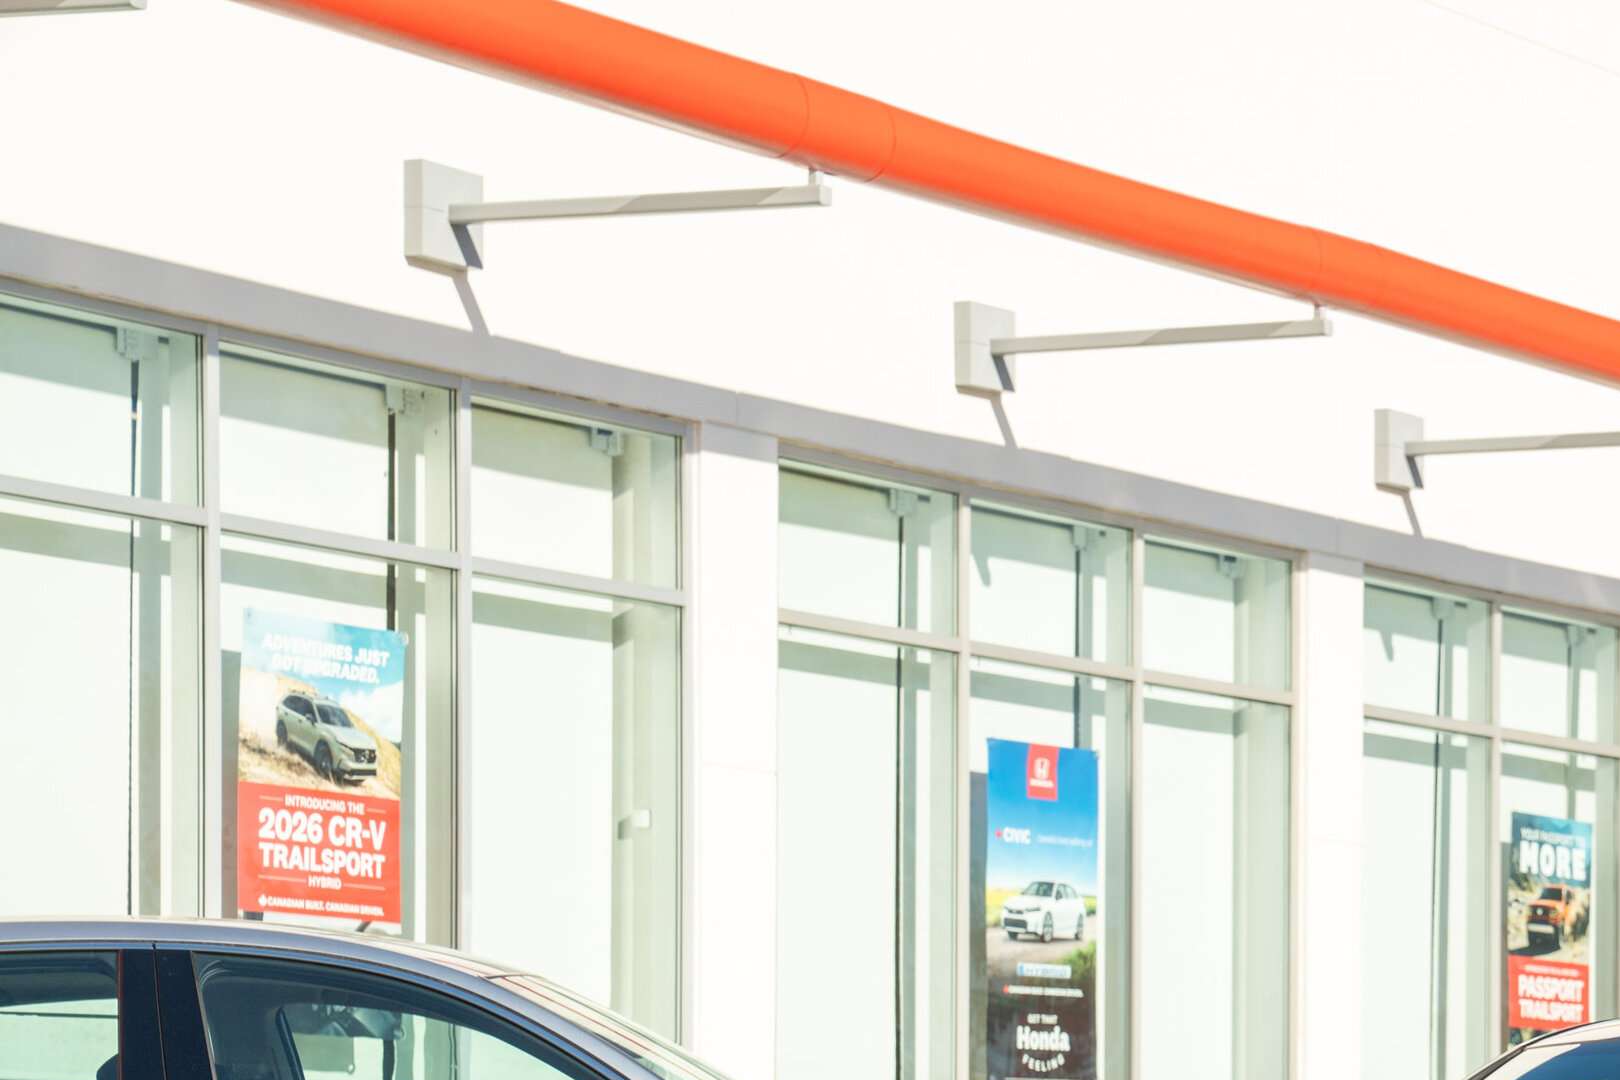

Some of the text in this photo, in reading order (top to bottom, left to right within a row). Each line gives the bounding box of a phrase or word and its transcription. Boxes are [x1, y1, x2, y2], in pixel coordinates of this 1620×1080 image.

[354, 647, 390, 668] JUST
[285, 794, 365, 815] INTRODUCING THE
[258, 807, 386, 851] 2026 CR-V
[1003, 826, 1031, 844] CIVIC
[258, 841, 386, 879] TRAILSPORT
[1520, 840, 1586, 881] MORE
[308, 876, 342, 890] HYBRID
[1016, 1025, 1071, 1052] Honda
[1022, 1053, 1065, 1073] FEELING
